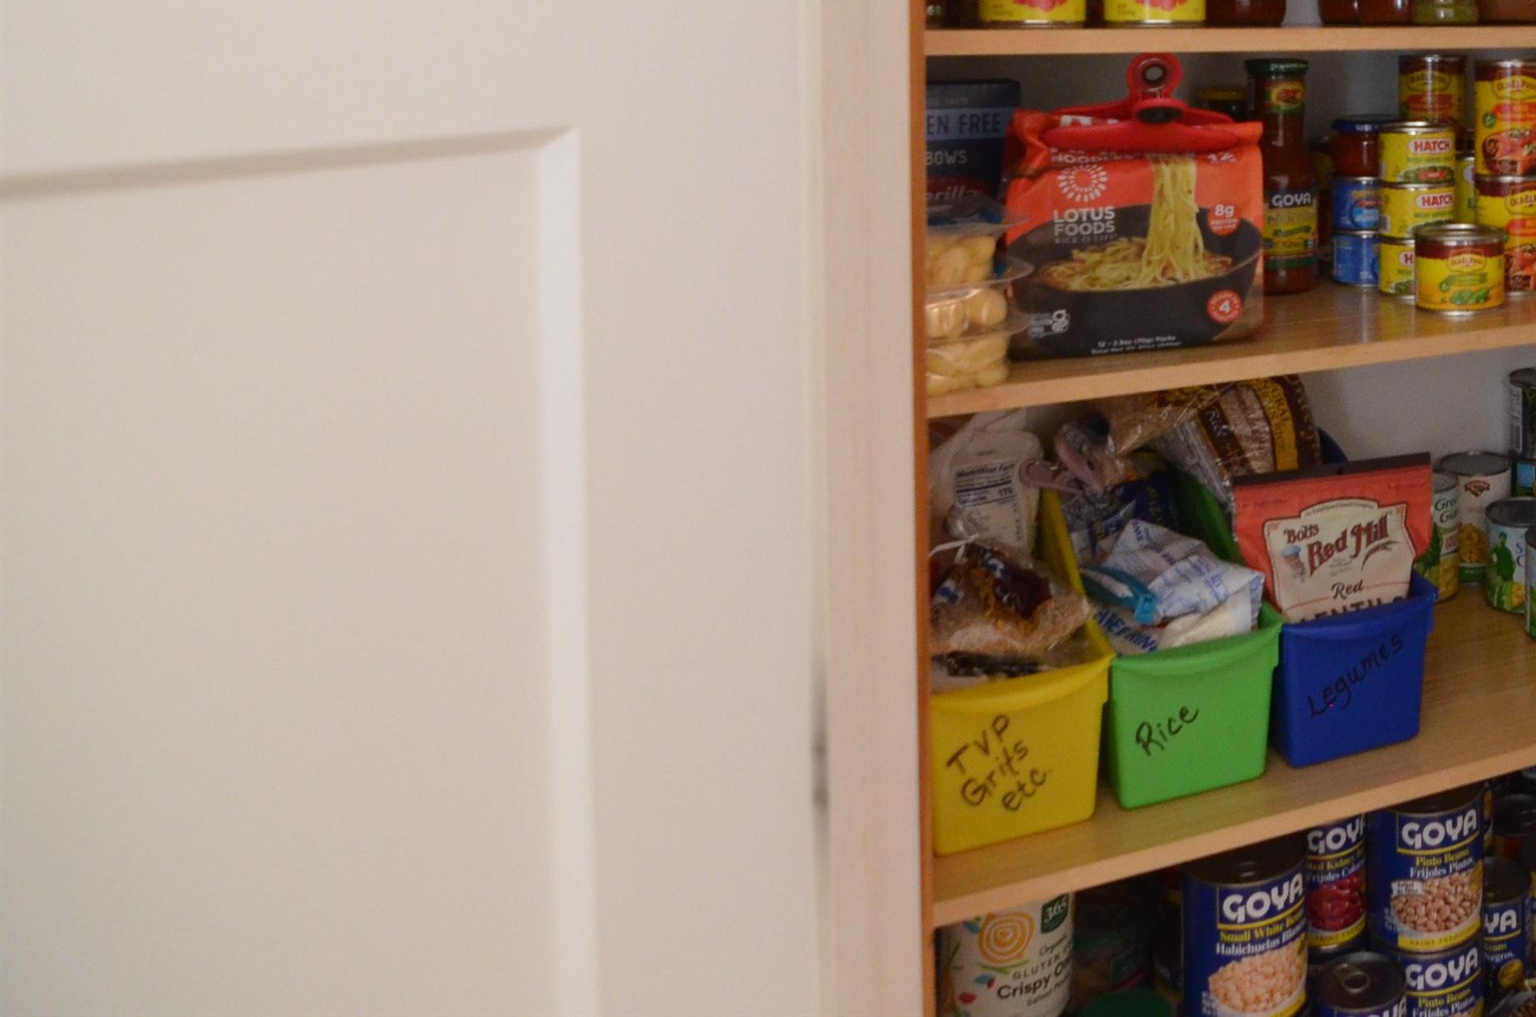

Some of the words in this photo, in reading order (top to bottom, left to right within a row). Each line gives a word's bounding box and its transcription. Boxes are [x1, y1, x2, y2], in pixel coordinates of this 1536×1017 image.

[958, 111, 1002, 133] FREE
[1413, 138, 1450, 152] HATCH
[1213, 202, 1236, 220] 8g
[1271, 191, 1312, 207] GOYA
[1052, 205, 1117, 224] LOTUS
[1054, 220, 1117, 237] FOODS
[1283, 521, 1320, 545] Bob's
[1307, 526, 1349, 578] Red
[1348, 512, 1390, 560] Mill
[1331, 579, 1365, 601] Red
[1307, 632, 1406, 720] Legumes
[1134, 704, 1201, 759] Rice
[946, 713, 1011, 775] TVP
[960, 740, 1029, 809] Grits
[1401, 807, 1479, 851] GOYA
[1409, 862, 1449, 880] Frijoles
[1449, 856, 1476, 873] Pintos
[1415, 851, 1443, 868] Pinto
[1443, 846, 1470, 863] Beans
[1221, 872, 1304, 925] GOYA
[1219, 929, 1252, 944] Small
[1253, 922, 1284, 942] White
[1405, 949, 1480, 992] GOYA
[995, 972, 1053, 1002] Crispy
[1417, 994, 1444, 1009] Pinto
[1445, 987, 1472, 1003] Beans
